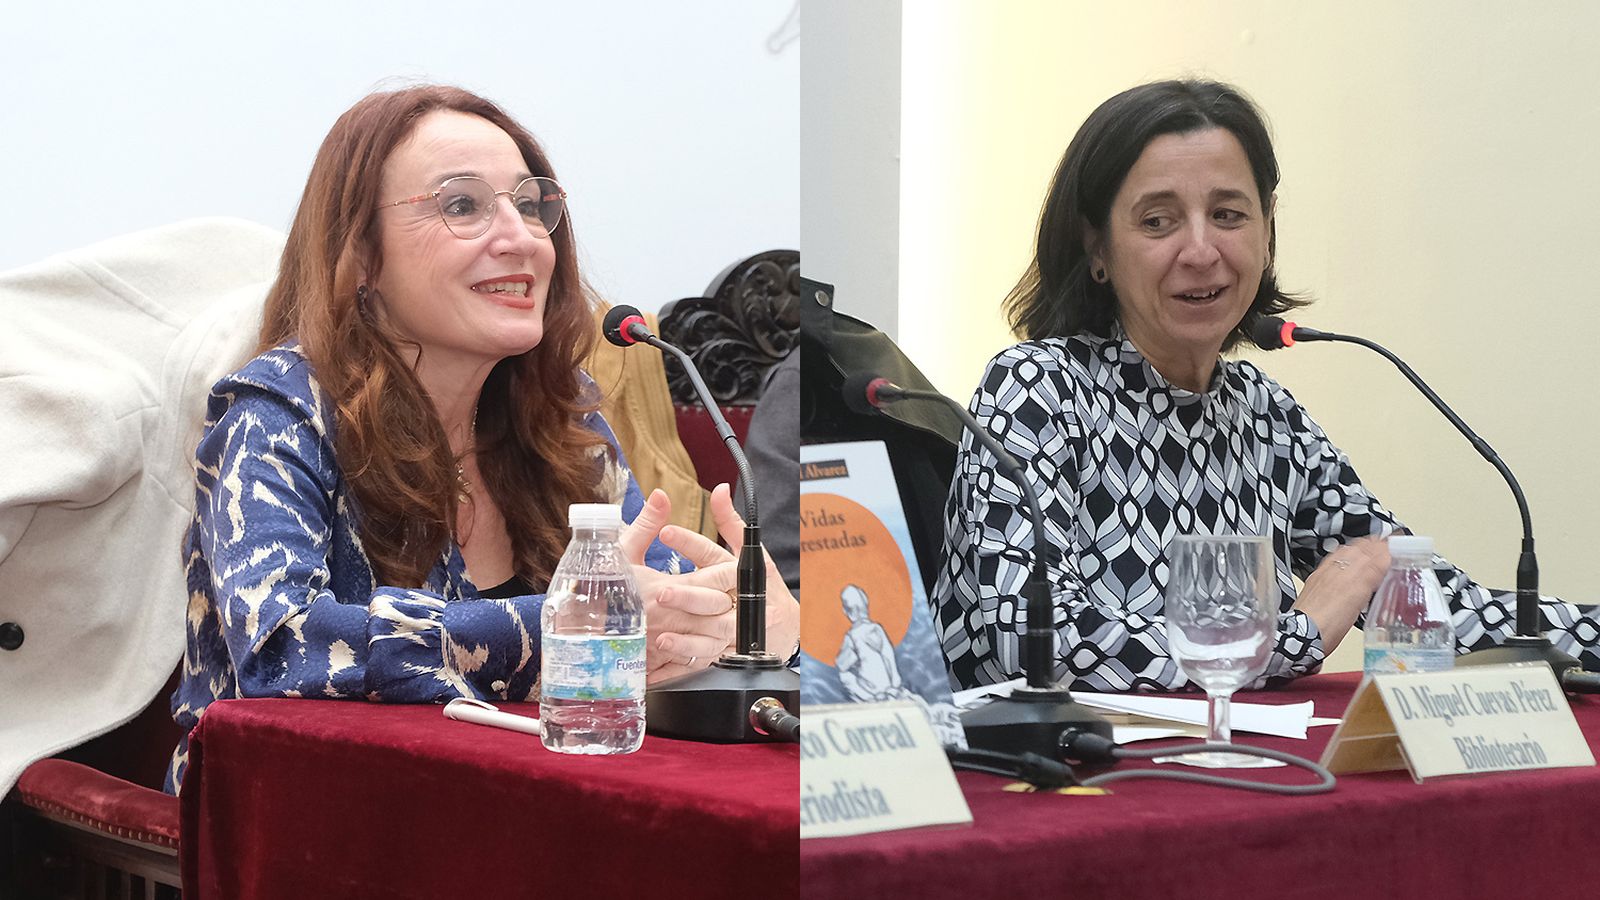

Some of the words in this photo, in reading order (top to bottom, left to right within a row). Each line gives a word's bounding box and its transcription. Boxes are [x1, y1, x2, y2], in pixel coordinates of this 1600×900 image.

[800, 508, 846, 529] Vidas
[616, 658, 646, 671] Fuente
[1391, 686, 1420, 721] D.
[1410, 684, 1470, 727] Miguel
[1463, 682, 1520, 717] Cuevas
[1510, 679, 1558, 713] Pérez
[823, 713, 917, 756] Correal
[1453, 732, 1549, 770] Bibliotecario
